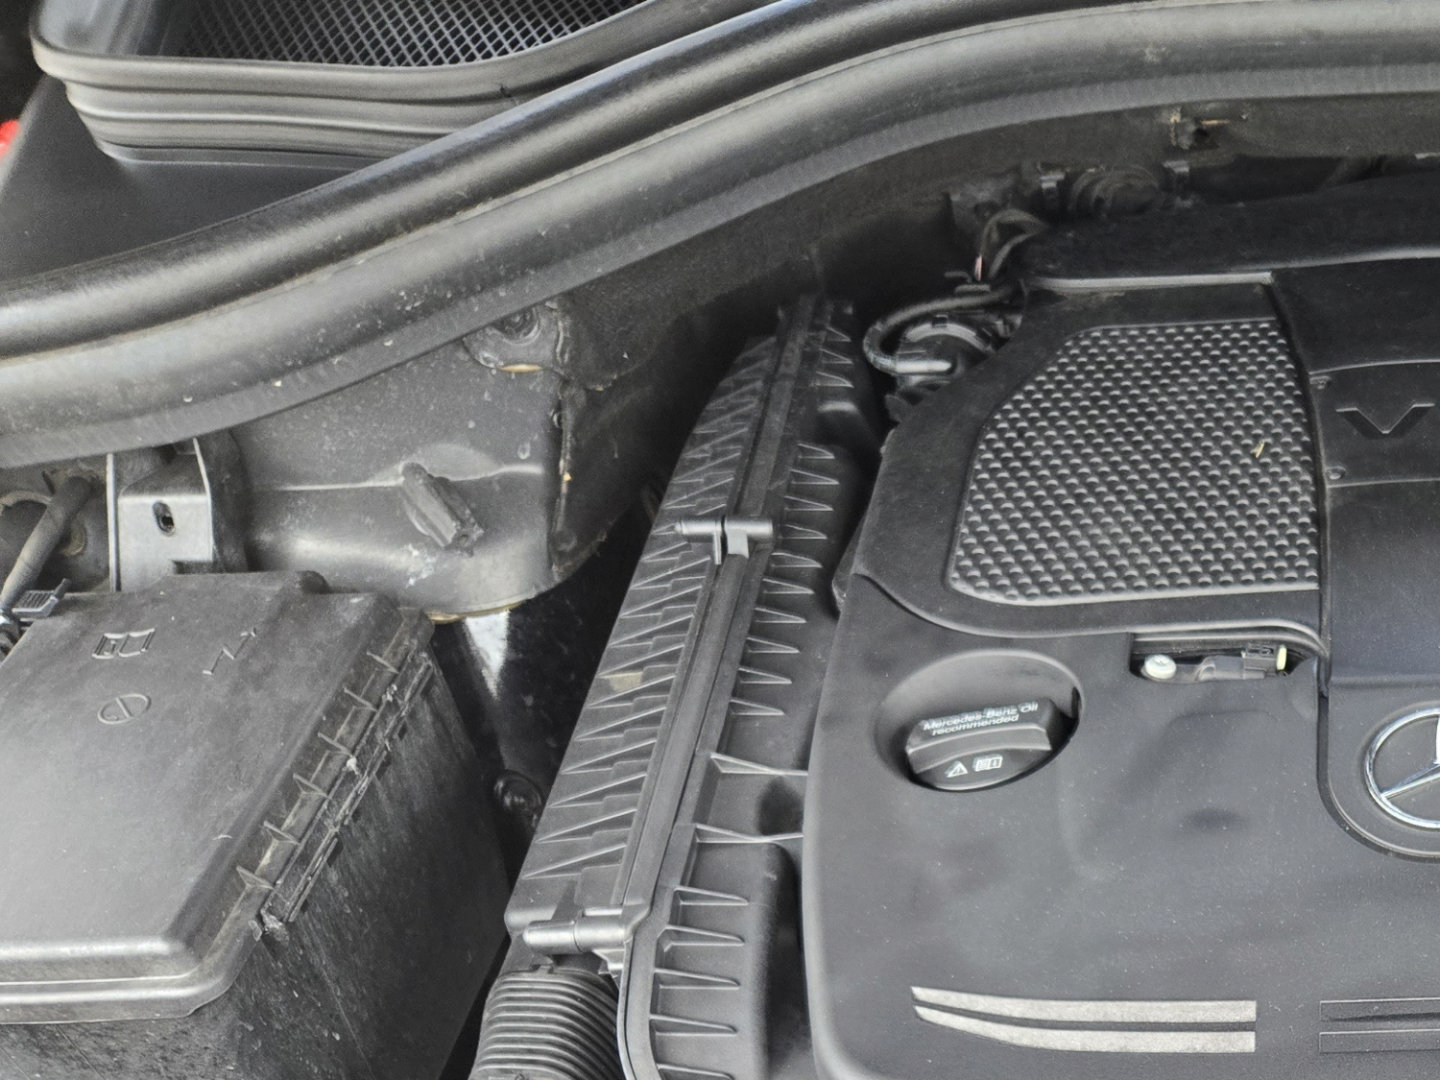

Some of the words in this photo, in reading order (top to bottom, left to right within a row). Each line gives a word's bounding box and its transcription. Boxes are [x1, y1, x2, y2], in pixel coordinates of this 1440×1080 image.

[923, 704, 1019, 731] Mercedes-Benz
[1018, 701, 1039, 713] Oil
[931, 714, 1020, 736] recommended
